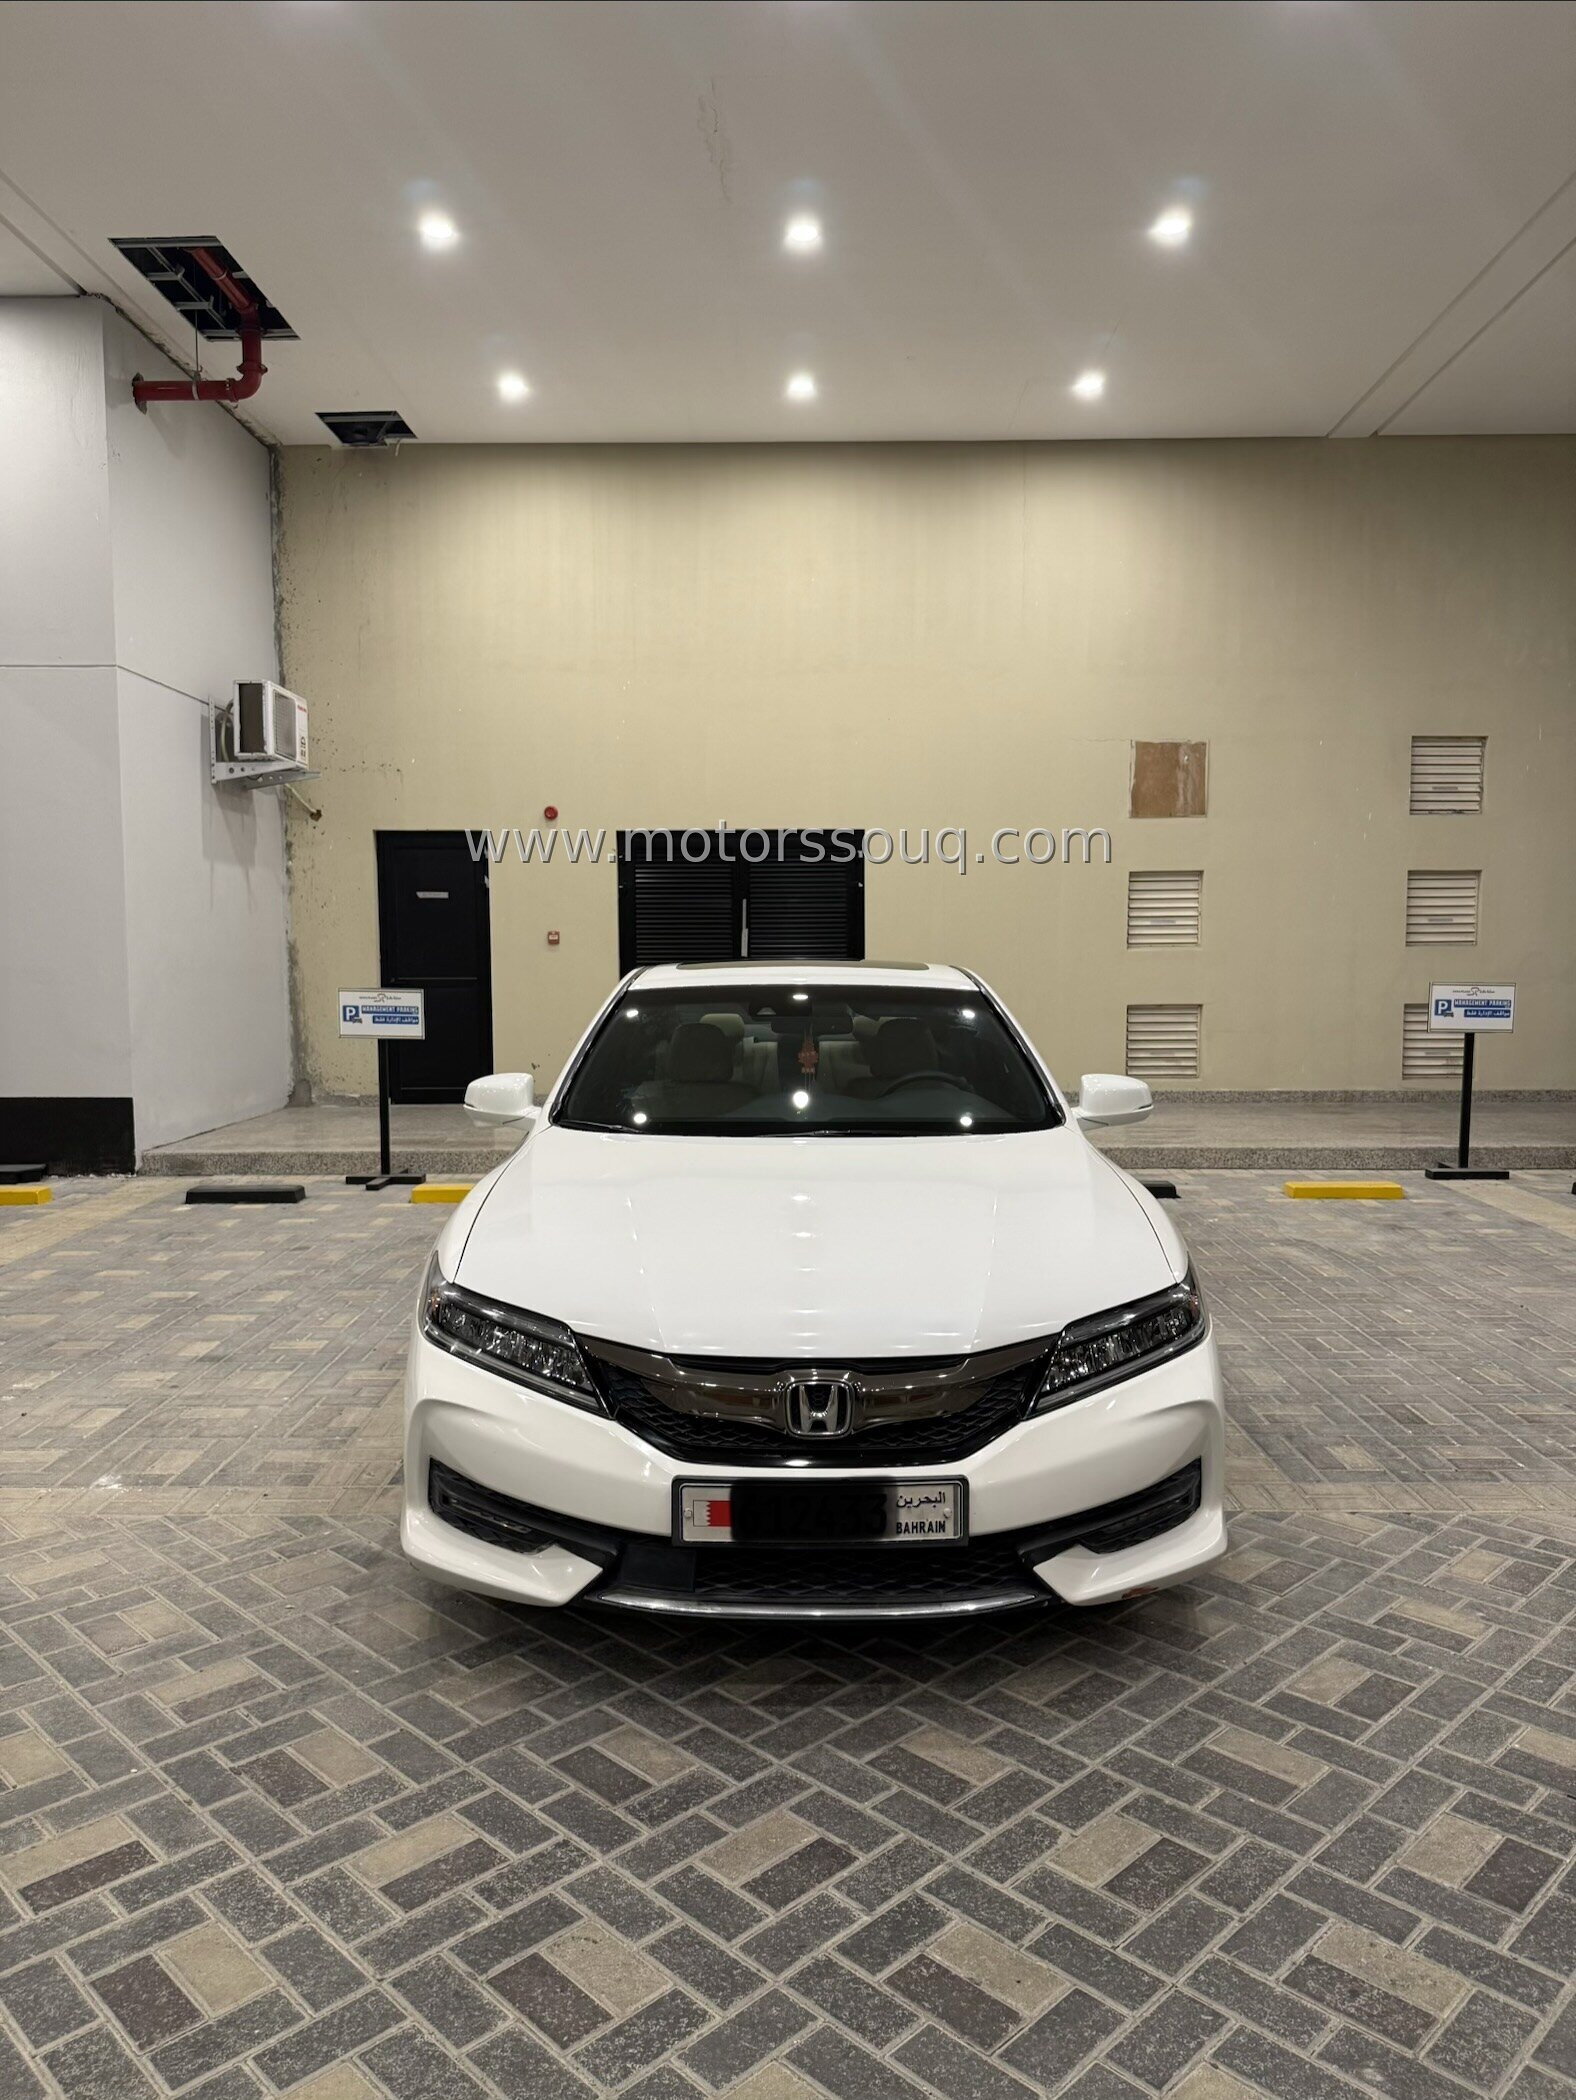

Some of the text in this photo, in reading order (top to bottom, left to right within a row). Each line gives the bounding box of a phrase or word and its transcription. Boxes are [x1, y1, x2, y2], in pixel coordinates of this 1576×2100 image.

[346, 1007, 356, 1020] P
[1438, 1001, 1448, 1014] P
[896, 1491, 946, 1509] البحرين
[896, 1520, 946, 1534] BAHRAIN
